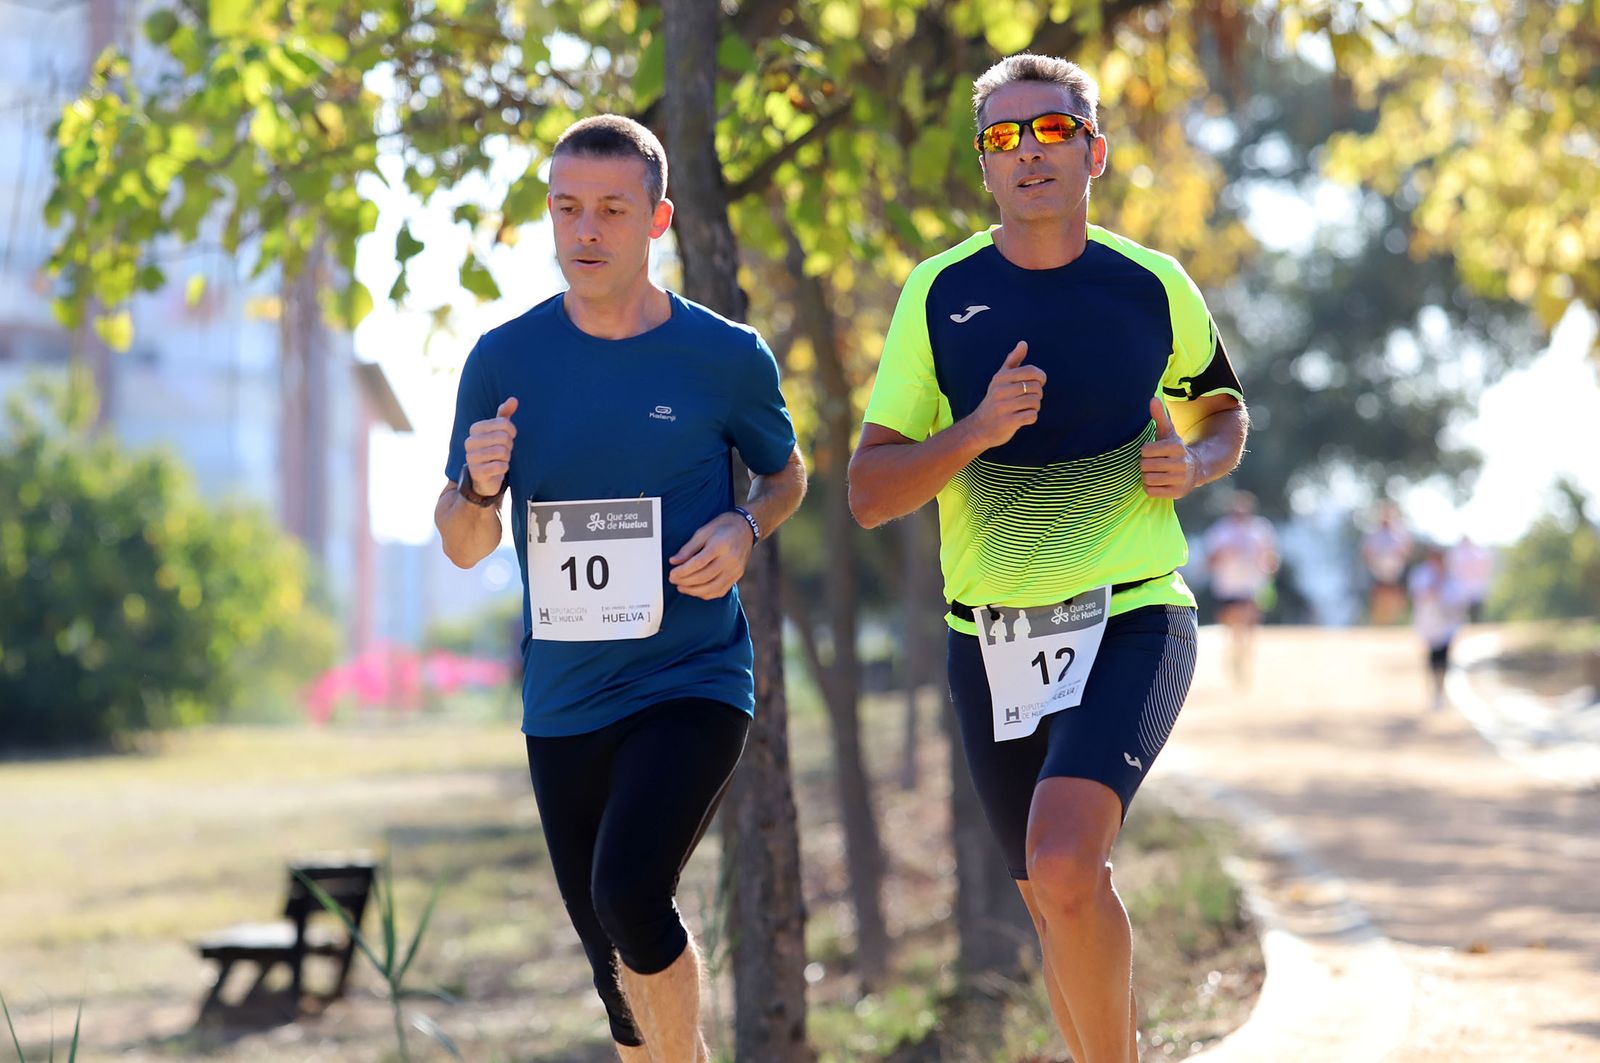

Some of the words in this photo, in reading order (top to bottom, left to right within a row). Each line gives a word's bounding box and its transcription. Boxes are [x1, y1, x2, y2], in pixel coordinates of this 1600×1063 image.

[607, 513, 623, 521] Que
[607, 521, 617, 529] de
[619, 521, 648, 529] Huelva
[561, 555, 609, 591] 10
[1070, 604, 1085, 613] Que
[1085, 602, 1096, 610] sea
[602, 612, 644, 623] HUELVA
[1070, 612, 1080, 621] de
[1081, 608, 1102, 620] Huelva
[1031, 647, 1076, 686] 12
